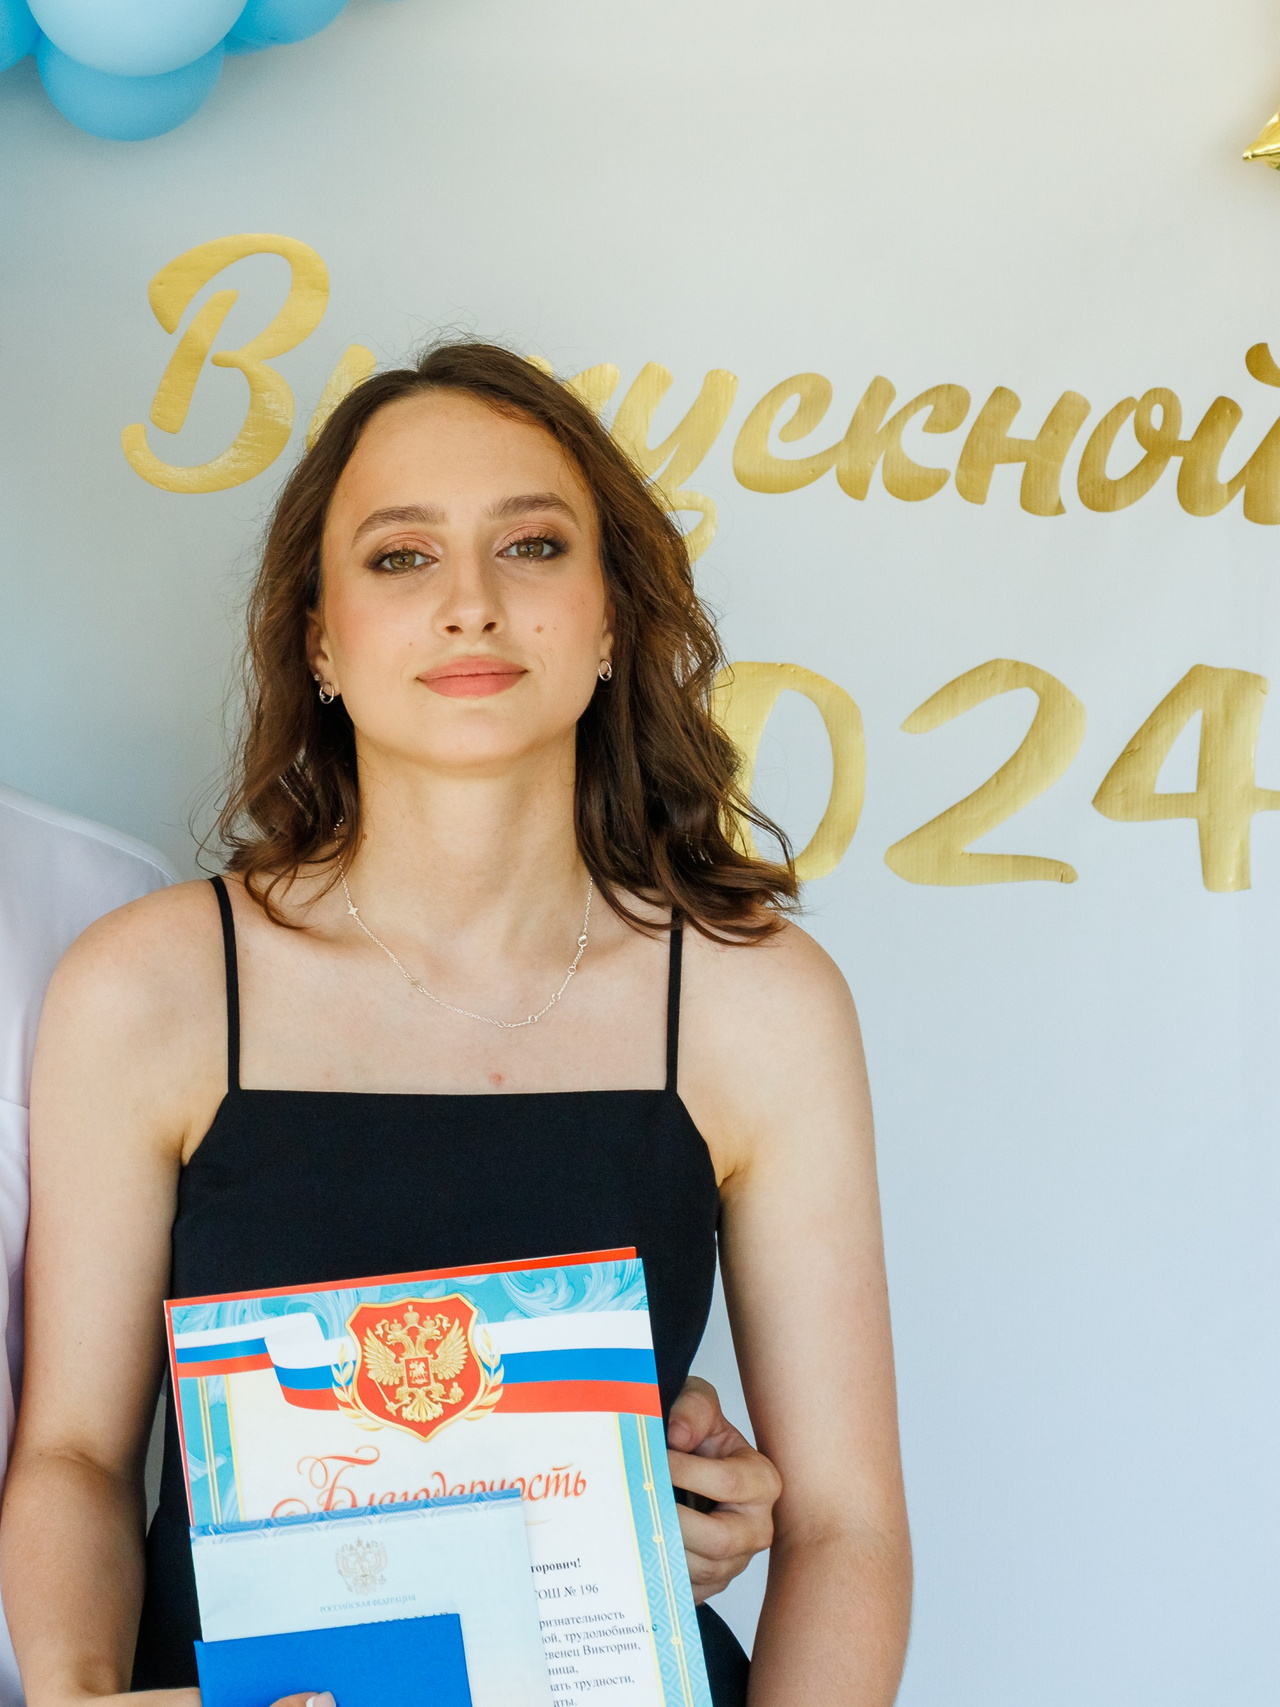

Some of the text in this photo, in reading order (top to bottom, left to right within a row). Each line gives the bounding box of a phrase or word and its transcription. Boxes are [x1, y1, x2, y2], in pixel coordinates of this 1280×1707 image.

[121, 232, 1280, 563] Вускной
[711, 658, 1280, 893] 024
[535, 1583, 599, 1600] ОШ № 196
[320, 1594, 416, 1613] РОССИЙСКАЯ ФЕДЕРАЦИЯ
[565, 1623, 649, 1643] трудолюбивой,
[582, 1642, 641, 1656] Виктории,
[574, 1675, 635, 1691] трудности,
